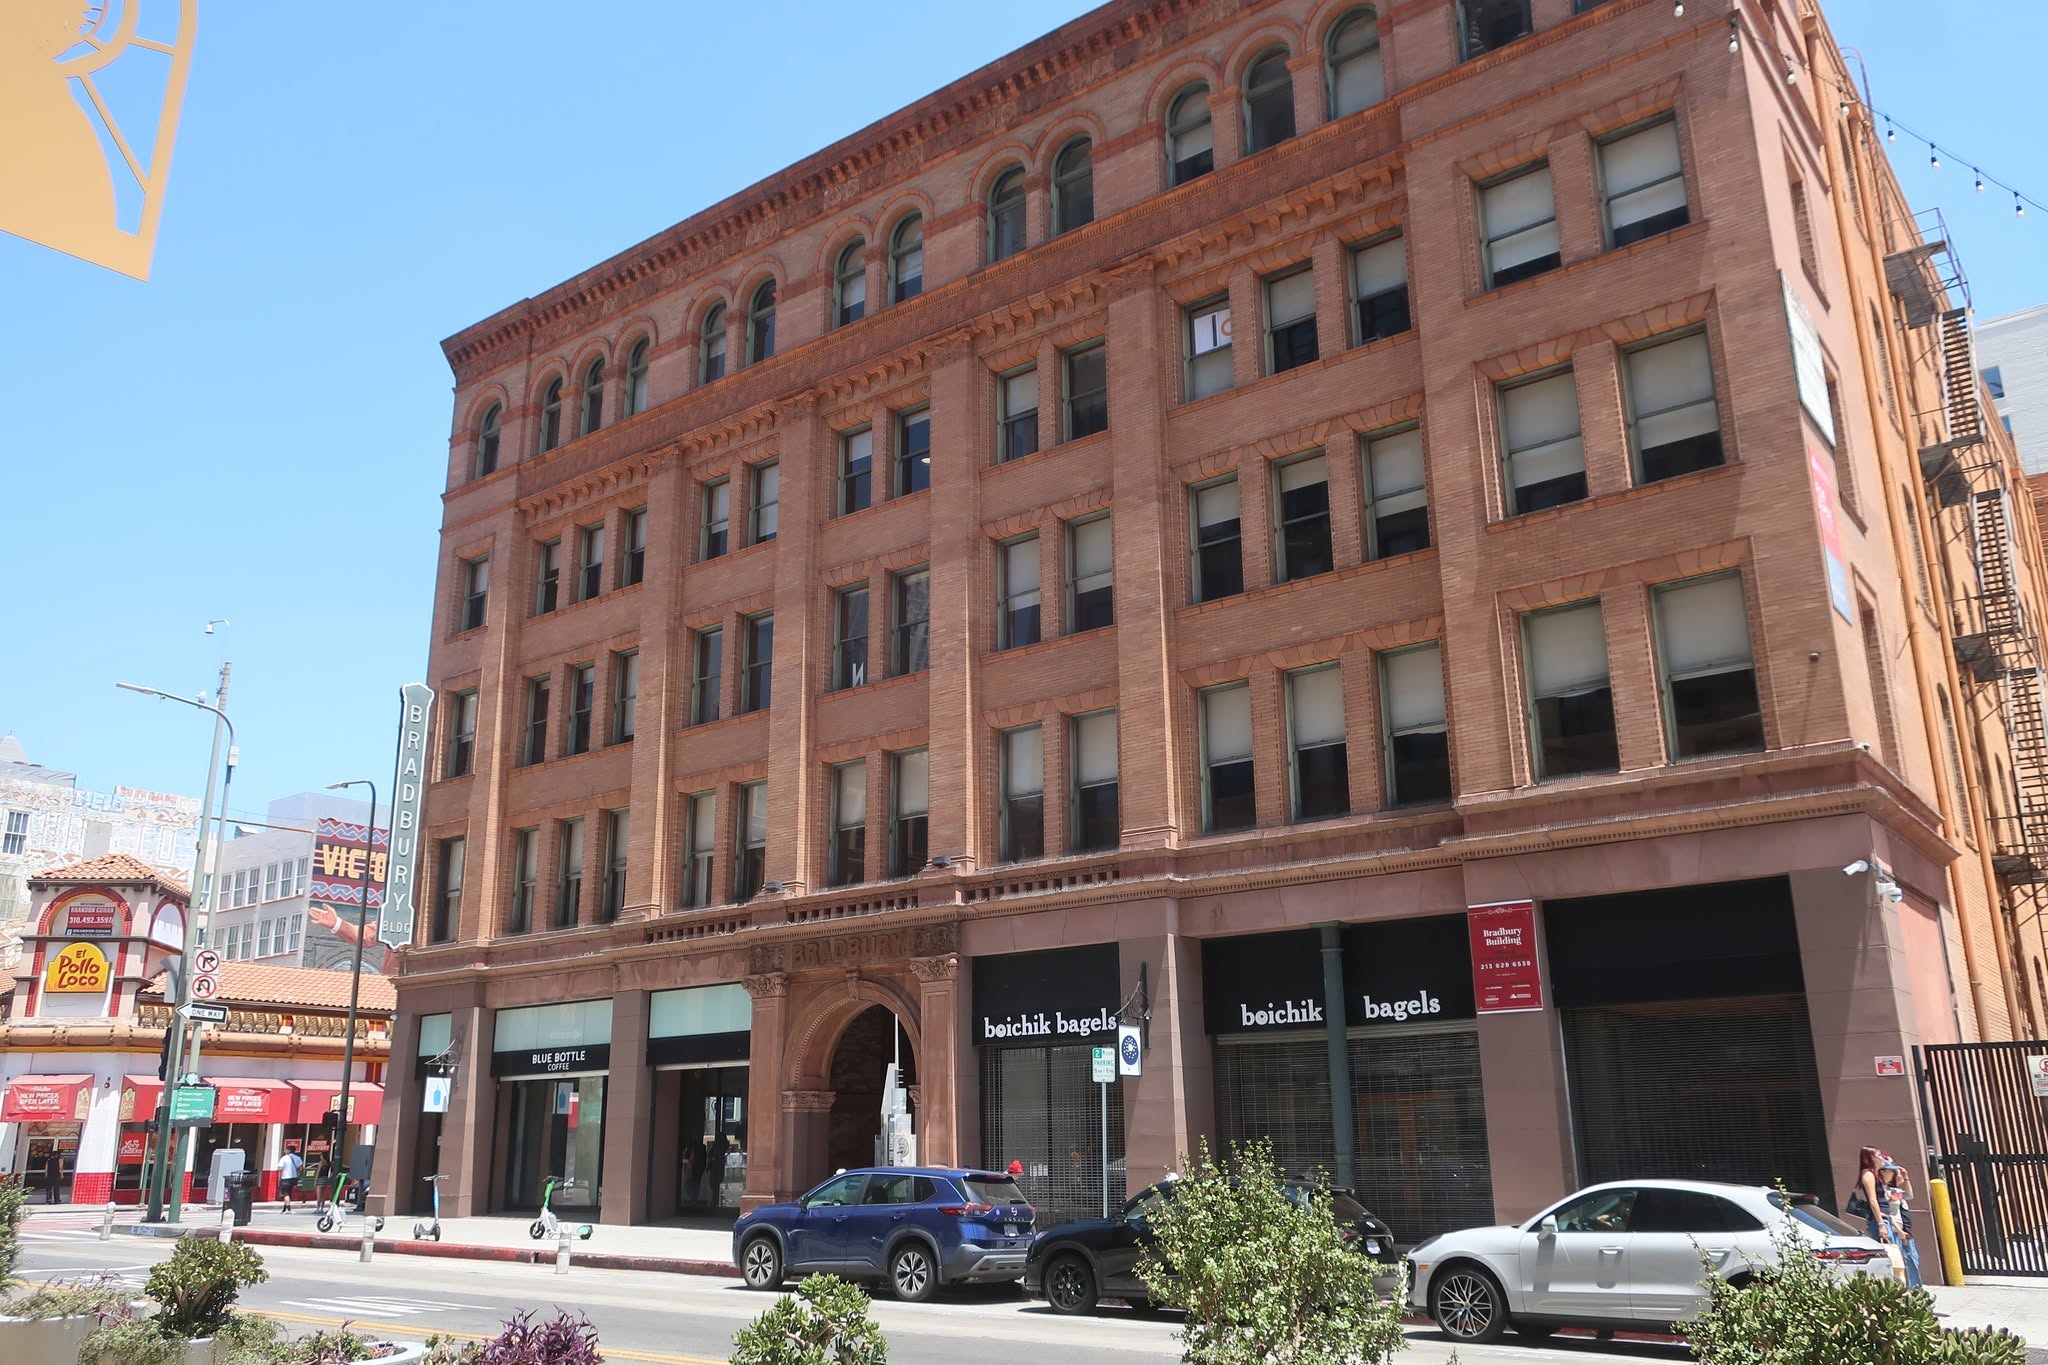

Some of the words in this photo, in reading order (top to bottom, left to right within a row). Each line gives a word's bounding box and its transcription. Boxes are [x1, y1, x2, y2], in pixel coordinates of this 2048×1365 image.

[393, 704, 422, 912] BRADBURY
[383, 921, 410, 933] BLDG
[1483, 927, 1522, 938] Bradbury
[1486, 936, 1522, 946] Building
[76, 949, 87, 958] El
[792, 932, 908, 965] BRADBURY
[58, 955, 100, 974] Pollo
[58, 971, 99, 988] Loco
[1241, 999, 1323, 1026] boichik
[1363, 990, 1441, 1021] bagels
[984, 1013, 1051, 1038] boichik
[1056, 1008, 1117, 1036] bagels
[532, 1053, 552, 1064] BLUE
[554, 1050, 586, 1062] BOTTLE
[1095, 1050, 1100, 1058] 2
[548, 1062, 570, 1071] COFFEE
